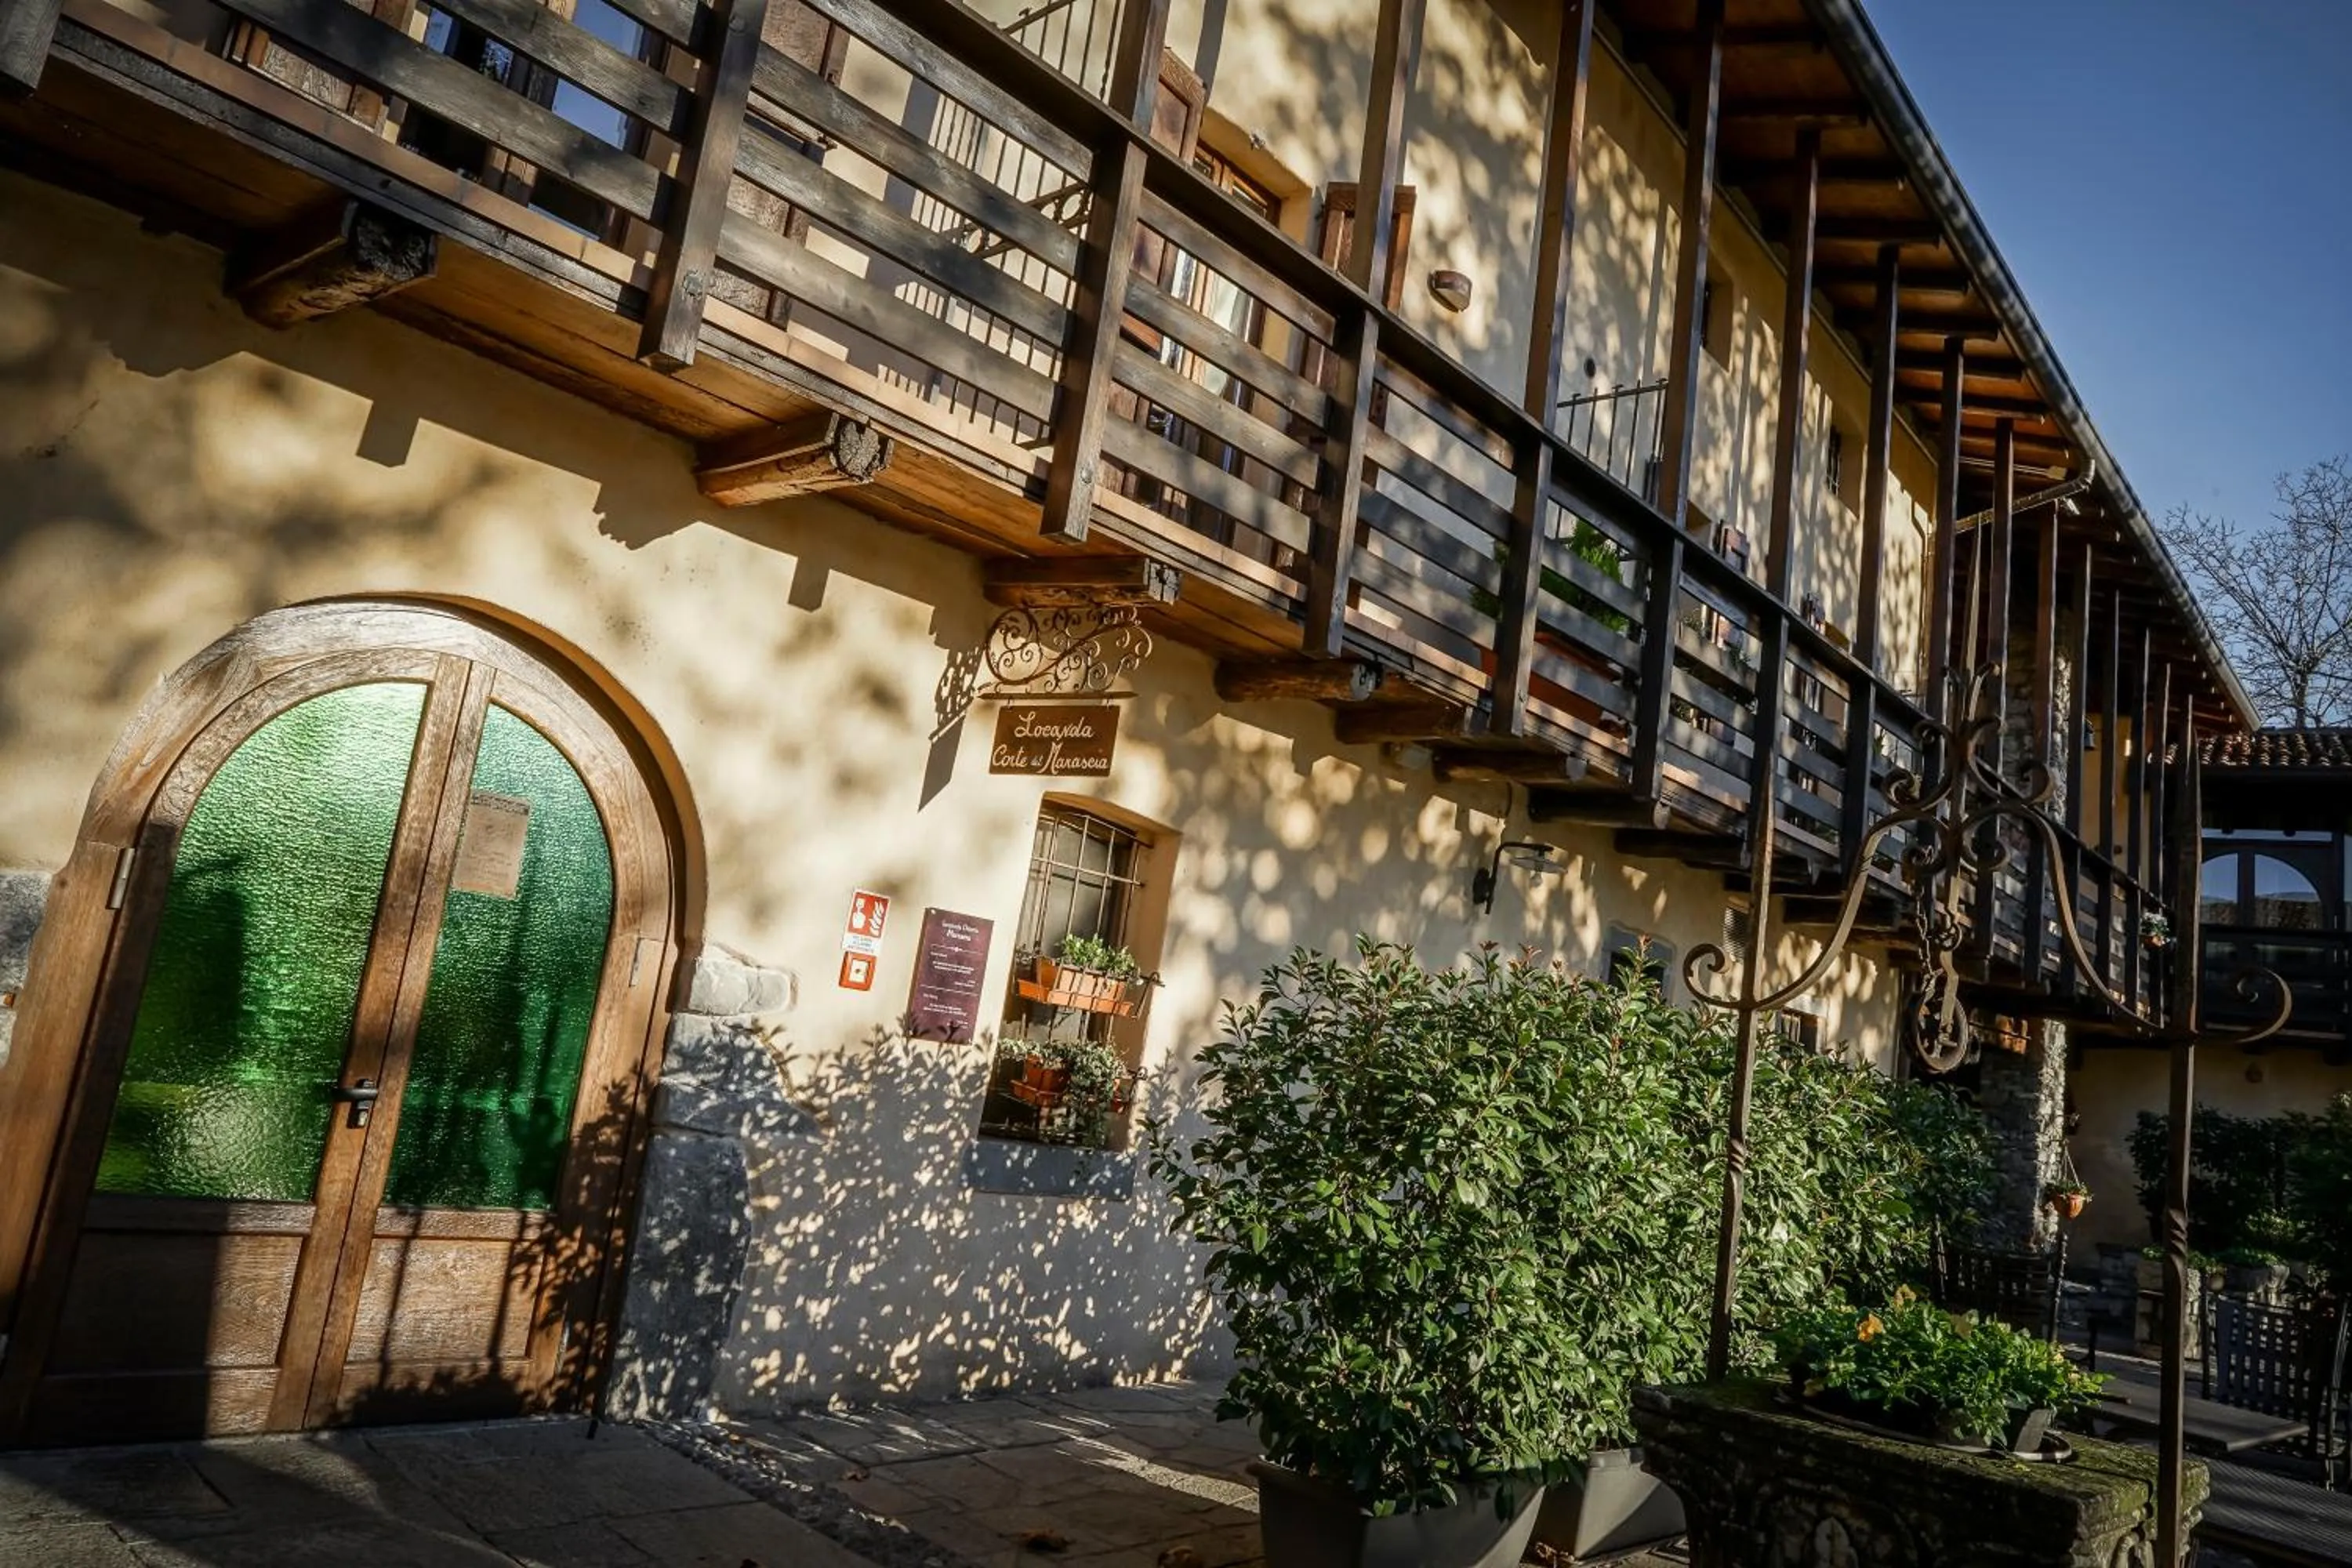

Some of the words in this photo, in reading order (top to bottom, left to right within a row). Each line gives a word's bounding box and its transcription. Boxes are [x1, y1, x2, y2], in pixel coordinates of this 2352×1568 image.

[1014, 711, 1095, 740] Locanda
[993, 744, 1028, 767] Corte
[1036, 741, 1109, 775] Marascia
